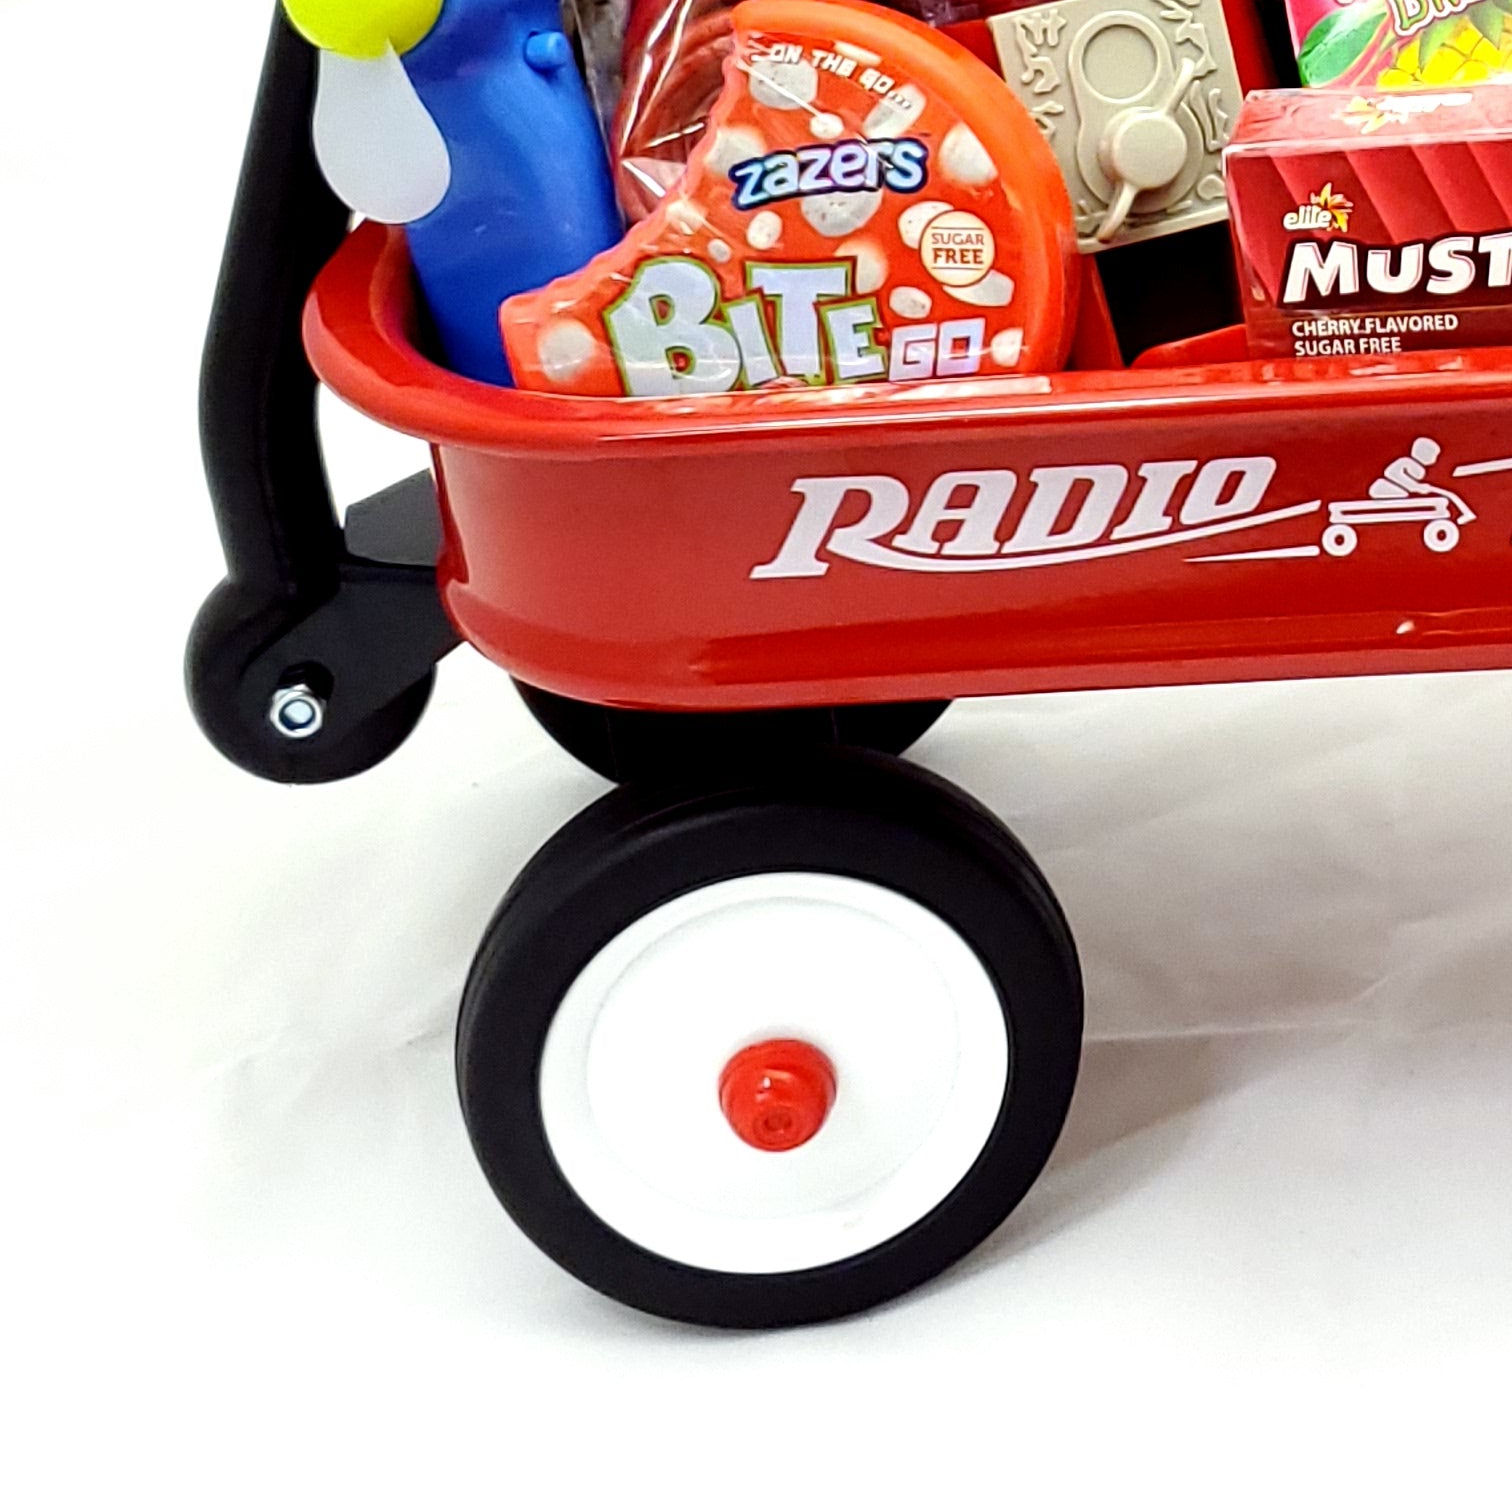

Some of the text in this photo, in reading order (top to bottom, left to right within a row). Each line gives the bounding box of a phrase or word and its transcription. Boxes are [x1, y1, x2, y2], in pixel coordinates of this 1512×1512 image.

[769, 43, 803, 64] ON
[811, 49, 858, 78] THE
[734, 140, 926, 208] zazers
[1283, 204, 1332, 230] elite
[930, 229, 986, 249] SUGAR
[932, 247, 985, 267] FREE
[889, 317, 986, 382] GO
[1294, 337, 1402, 357] SUGAR FREE
[747, 455, 1280, 579] RADIO
